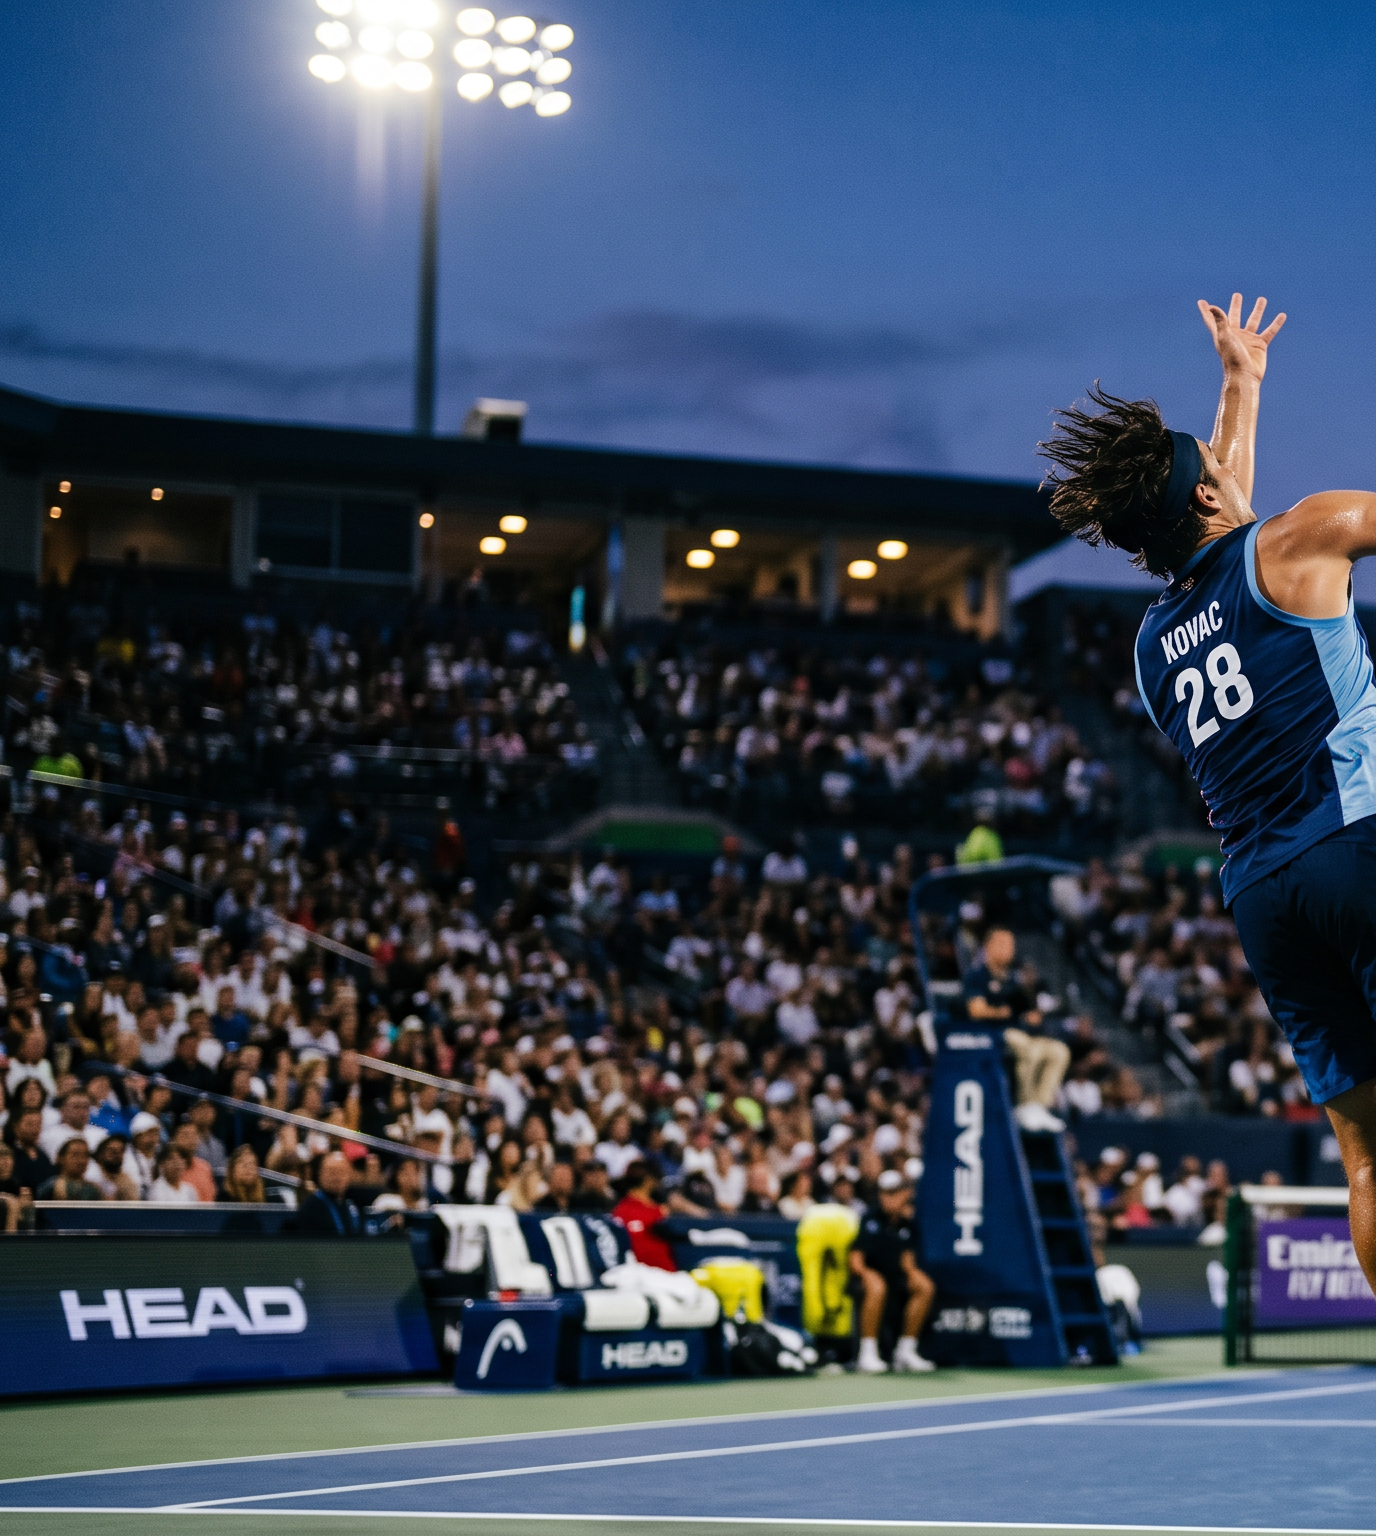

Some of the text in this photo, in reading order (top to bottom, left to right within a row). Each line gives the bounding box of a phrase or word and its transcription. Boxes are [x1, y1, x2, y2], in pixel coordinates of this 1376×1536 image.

[1160, 600, 1223, 665] KOVAC
[1174, 642, 1254, 749] 28
[953, 1079, 984, 1256] HEAD
[59, 1285, 308, 1341] HEAD
[601, 1340, 688, 1369] HEAD
